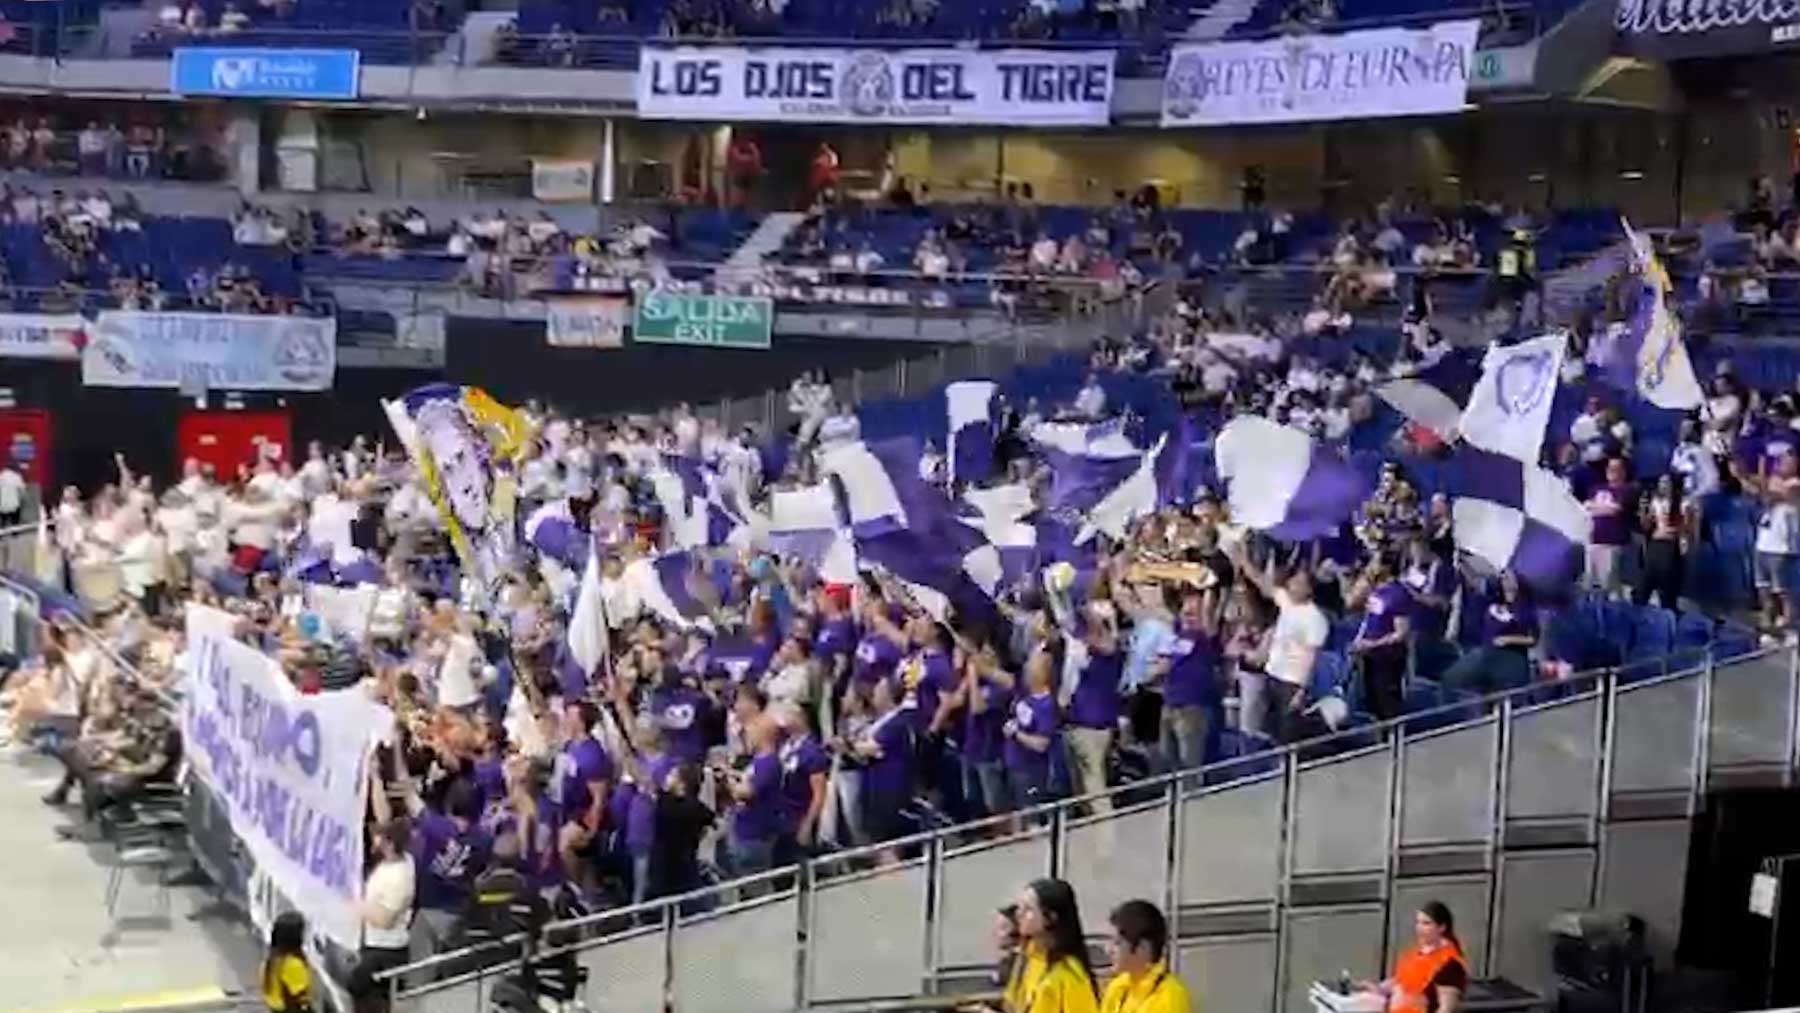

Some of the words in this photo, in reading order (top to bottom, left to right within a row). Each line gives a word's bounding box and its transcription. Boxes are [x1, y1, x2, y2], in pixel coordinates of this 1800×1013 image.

[652, 60, 722, 96] LOS
[744, 60, 834, 99] OJOS
[902, 64, 976, 100] DEL
[996, 64, 1108, 102] TIGRE
[641, 297, 762, 324] SALIDA
[674, 323, 728, 345] EXIT
